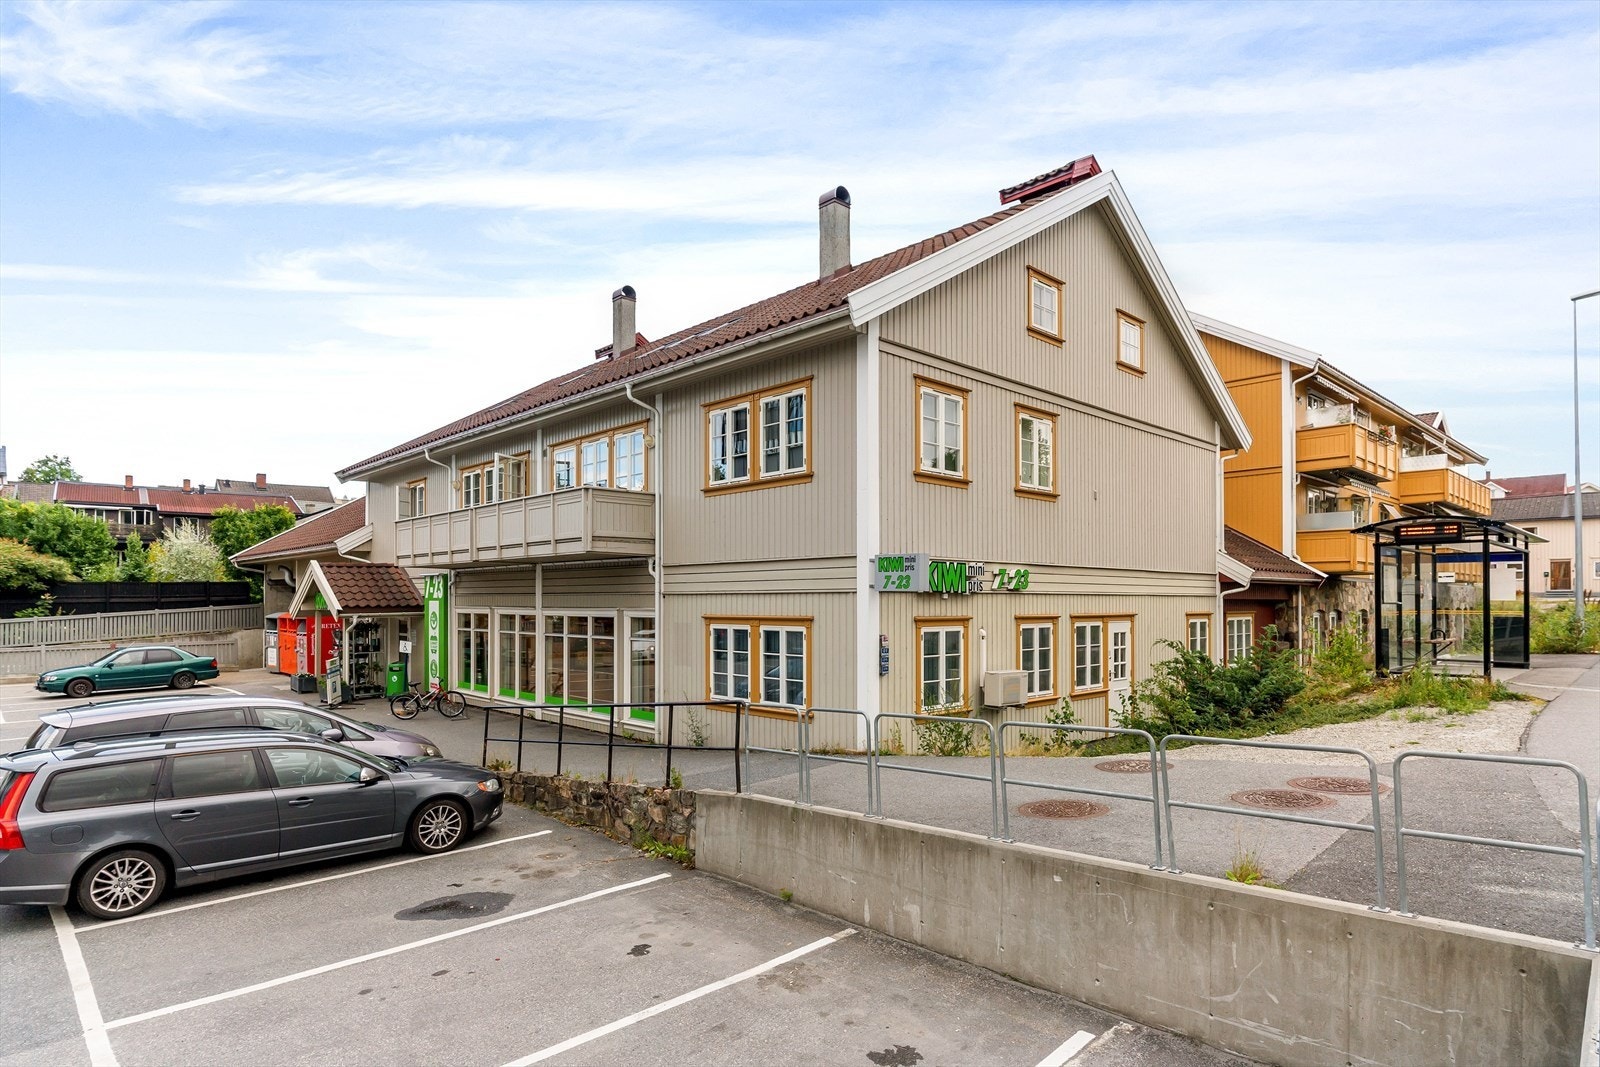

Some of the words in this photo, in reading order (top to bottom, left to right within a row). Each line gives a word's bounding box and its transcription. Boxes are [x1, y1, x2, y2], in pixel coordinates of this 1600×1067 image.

[878, 556, 904, 572] KIWI
[905, 555, 917, 563] mini
[905, 563, 915, 572] pris
[968, 562, 985, 576] mini
[882, 574, 912, 589] 7-23
[928, 561, 967, 593] KIWI
[424, 575, 443, 599] 7-23
[968, 578, 984, 593] pris
